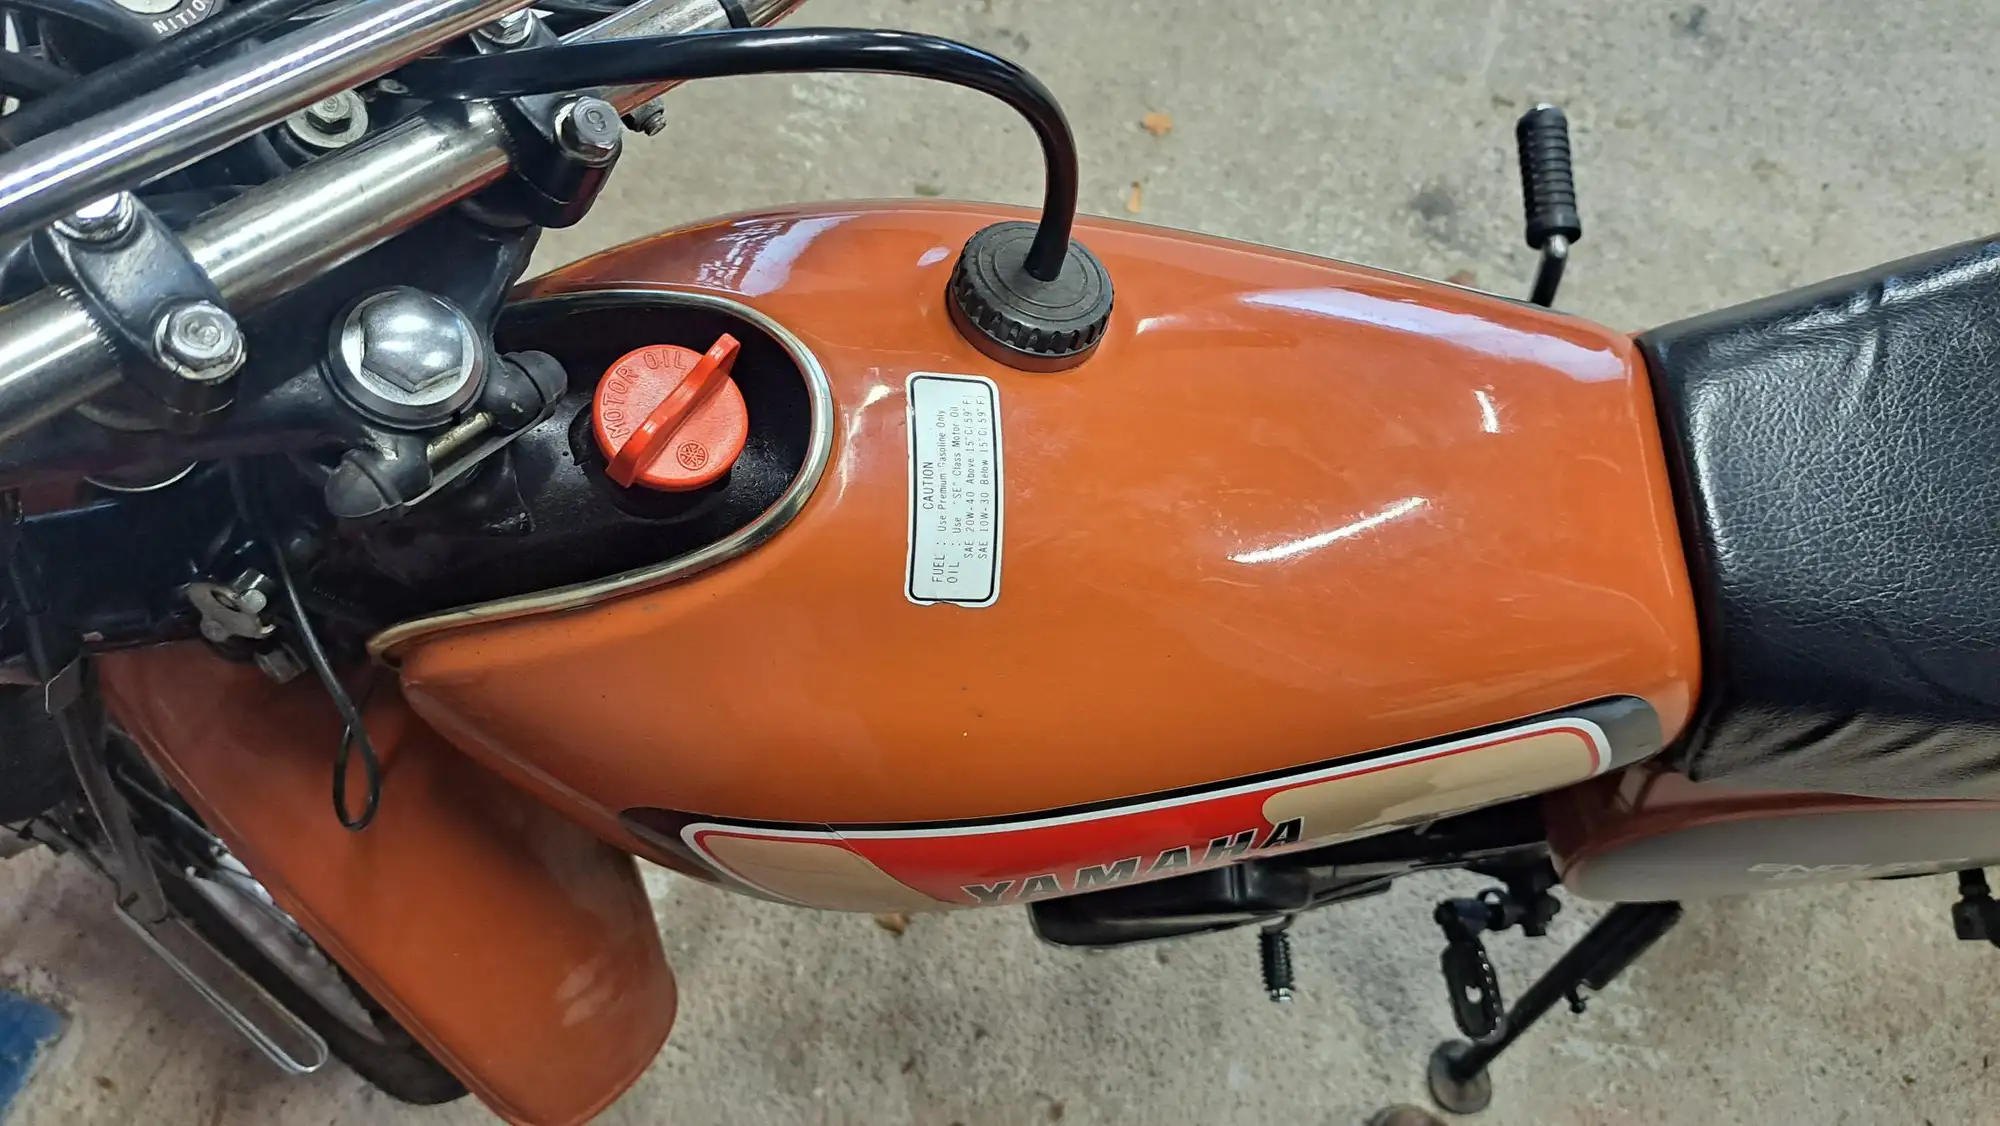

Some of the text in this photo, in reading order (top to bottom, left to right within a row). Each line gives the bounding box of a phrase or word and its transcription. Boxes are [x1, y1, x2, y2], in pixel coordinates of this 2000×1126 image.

[152, 0, 207, 34] NITIO
[602, 349, 689, 439] MOTOR OIL
[936, 410, 945, 428] Only
[949, 406, 959, 418] Oil
[952, 423, 960, 448] Motor
[937, 432, 947, 468] Gasoline
[952, 452, 962, 476] Class
[966, 458, 974, 484] Above
[980, 460, 989, 485] Below
[922, 462, 934, 510] CAUTION
[937, 473, 947, 510] Premium
[937, 515, 947, 532] Use
[966, 491, 975, 532] 20W-40
[980, 492, 989, 532] 10W-30
[952, 517, 962, 534] Use
[964, 541, 974, 558] SAE
[978, 541, 988, 559] SAE
[932, 554, 945, 582] FUEL
[946, 562, 960, 584] OIL
[961, 817, 1305, 904] YAMAHA
